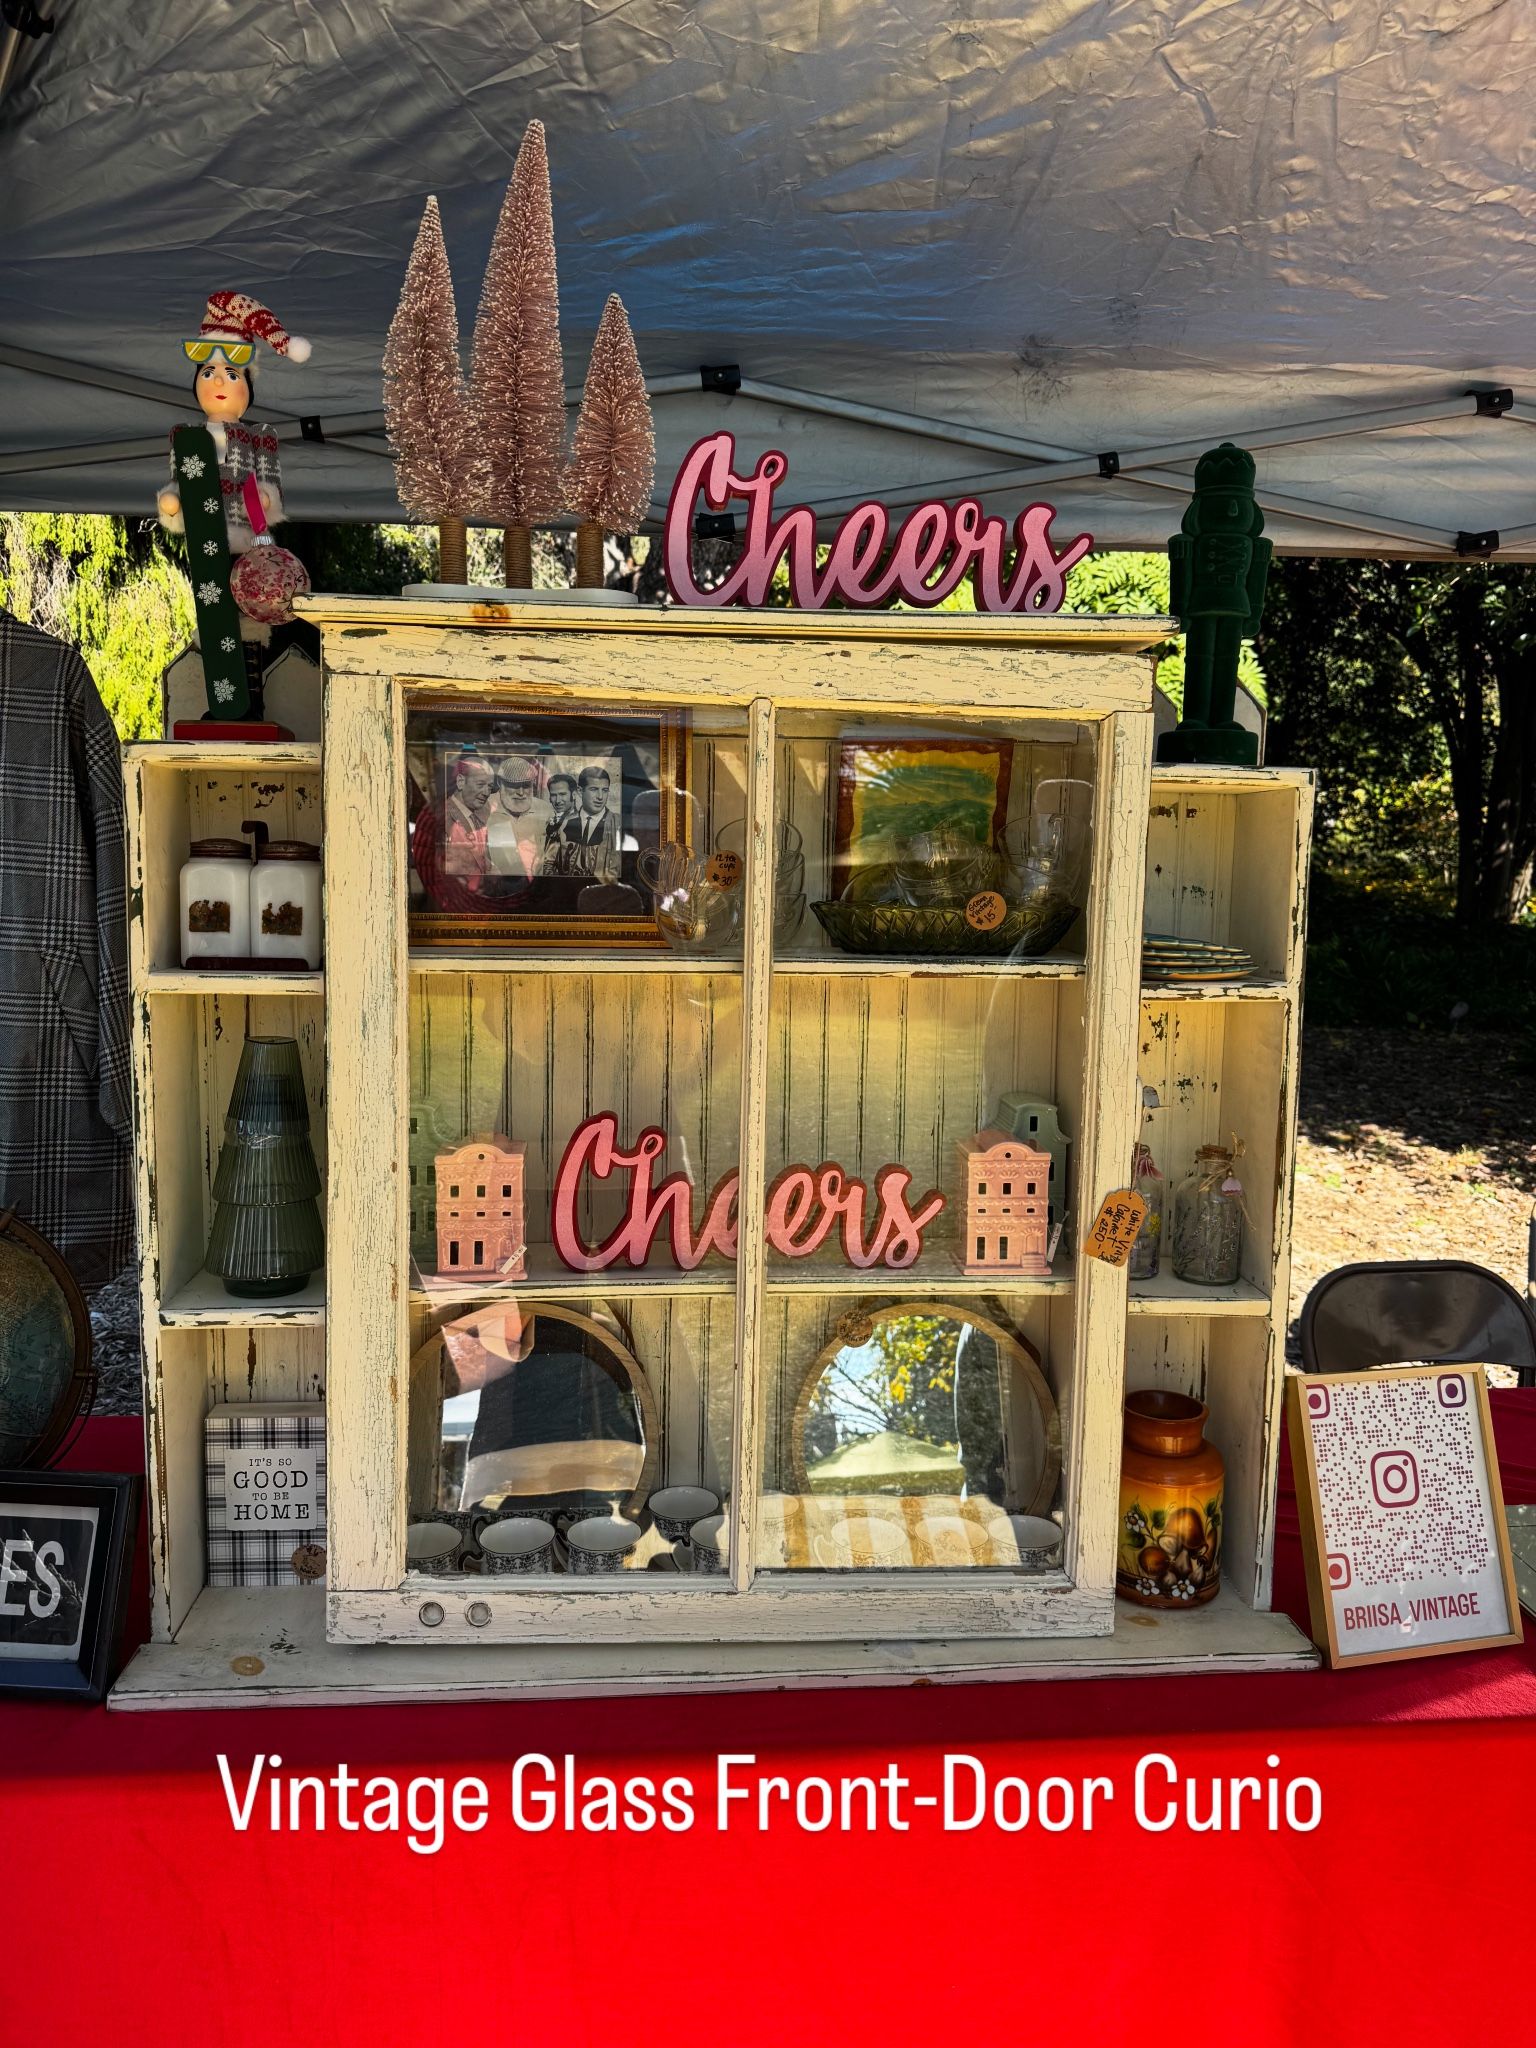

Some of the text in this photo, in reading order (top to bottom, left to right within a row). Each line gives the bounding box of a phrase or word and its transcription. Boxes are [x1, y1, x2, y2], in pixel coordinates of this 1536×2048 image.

[663, 430, 1094, 612] Cheers
[1106, 1203, 1131, 1248] Cabinet
[1124, 1209, 1142, 1237] White
[249, 1457, 293, 1467] IT'S SO
[233, 1470, 309, 1489] GOOD
[252, 1491, 290, 1501] TO BE
[233, 1503, 310, 1521] HOME
